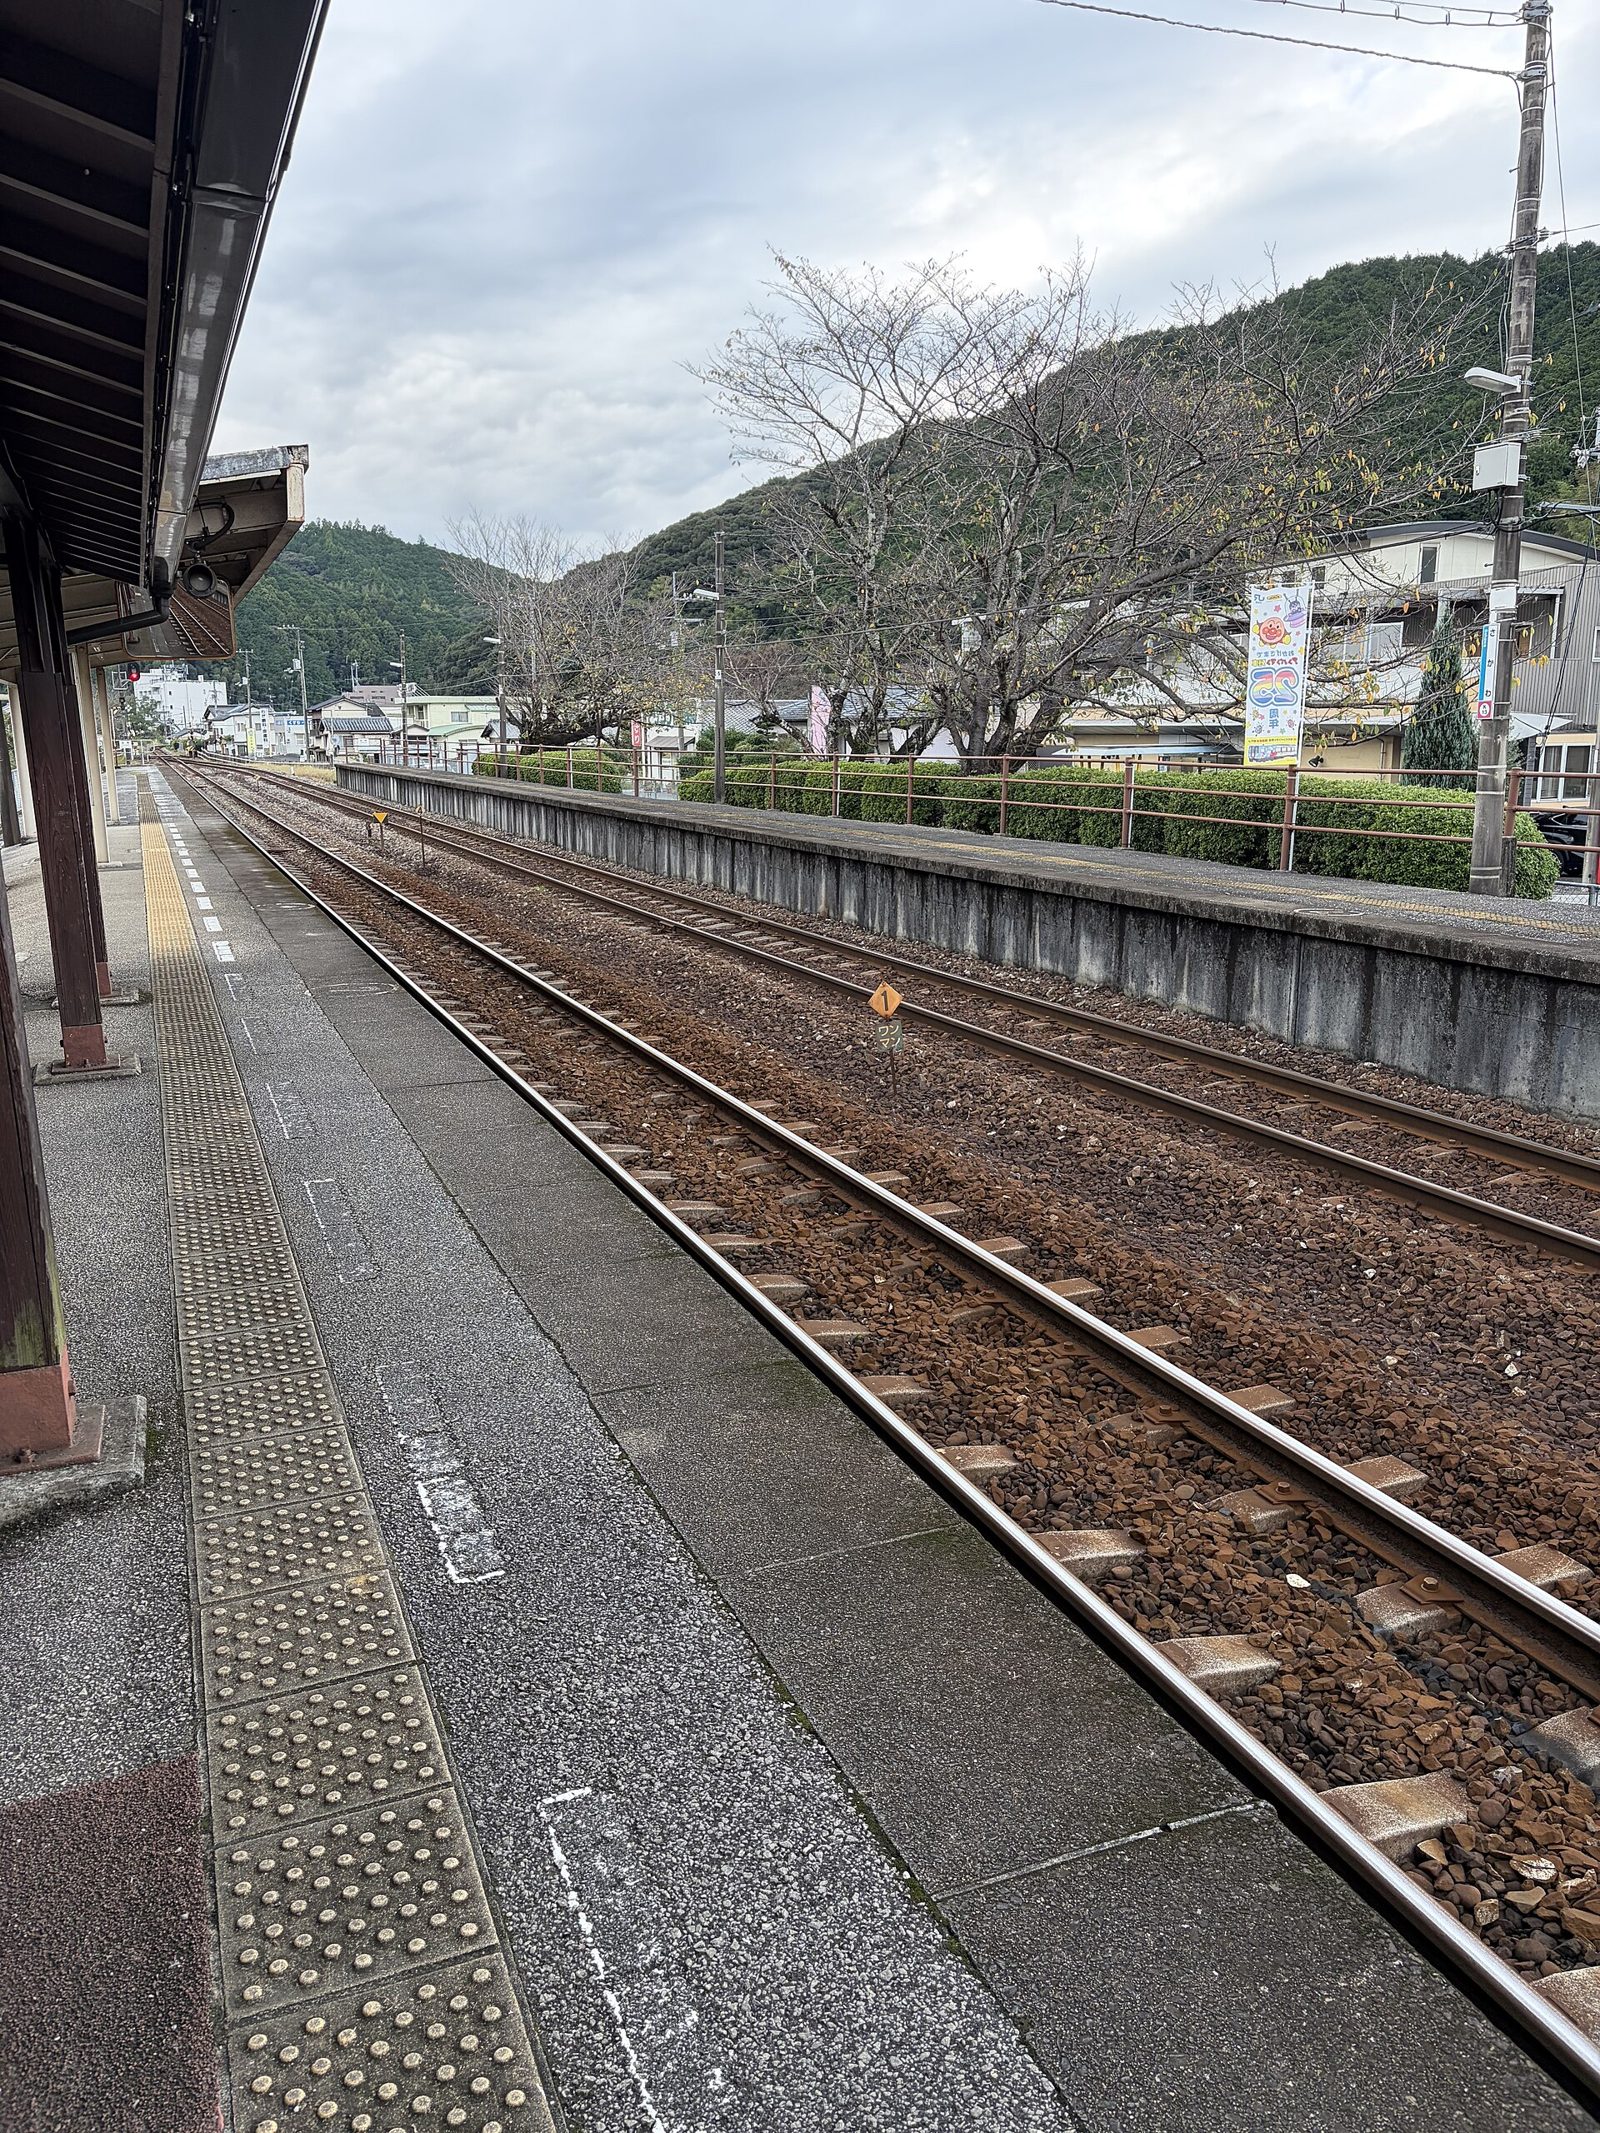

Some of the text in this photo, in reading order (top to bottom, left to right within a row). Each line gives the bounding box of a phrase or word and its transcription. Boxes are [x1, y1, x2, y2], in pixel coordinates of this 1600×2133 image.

[1485, 629, 1496, 697] さかわ
[880, 990, 889, 1012] 1
[878, 1025, 899, 1037] ワン
[879, 1037, 901, 1048] マン
